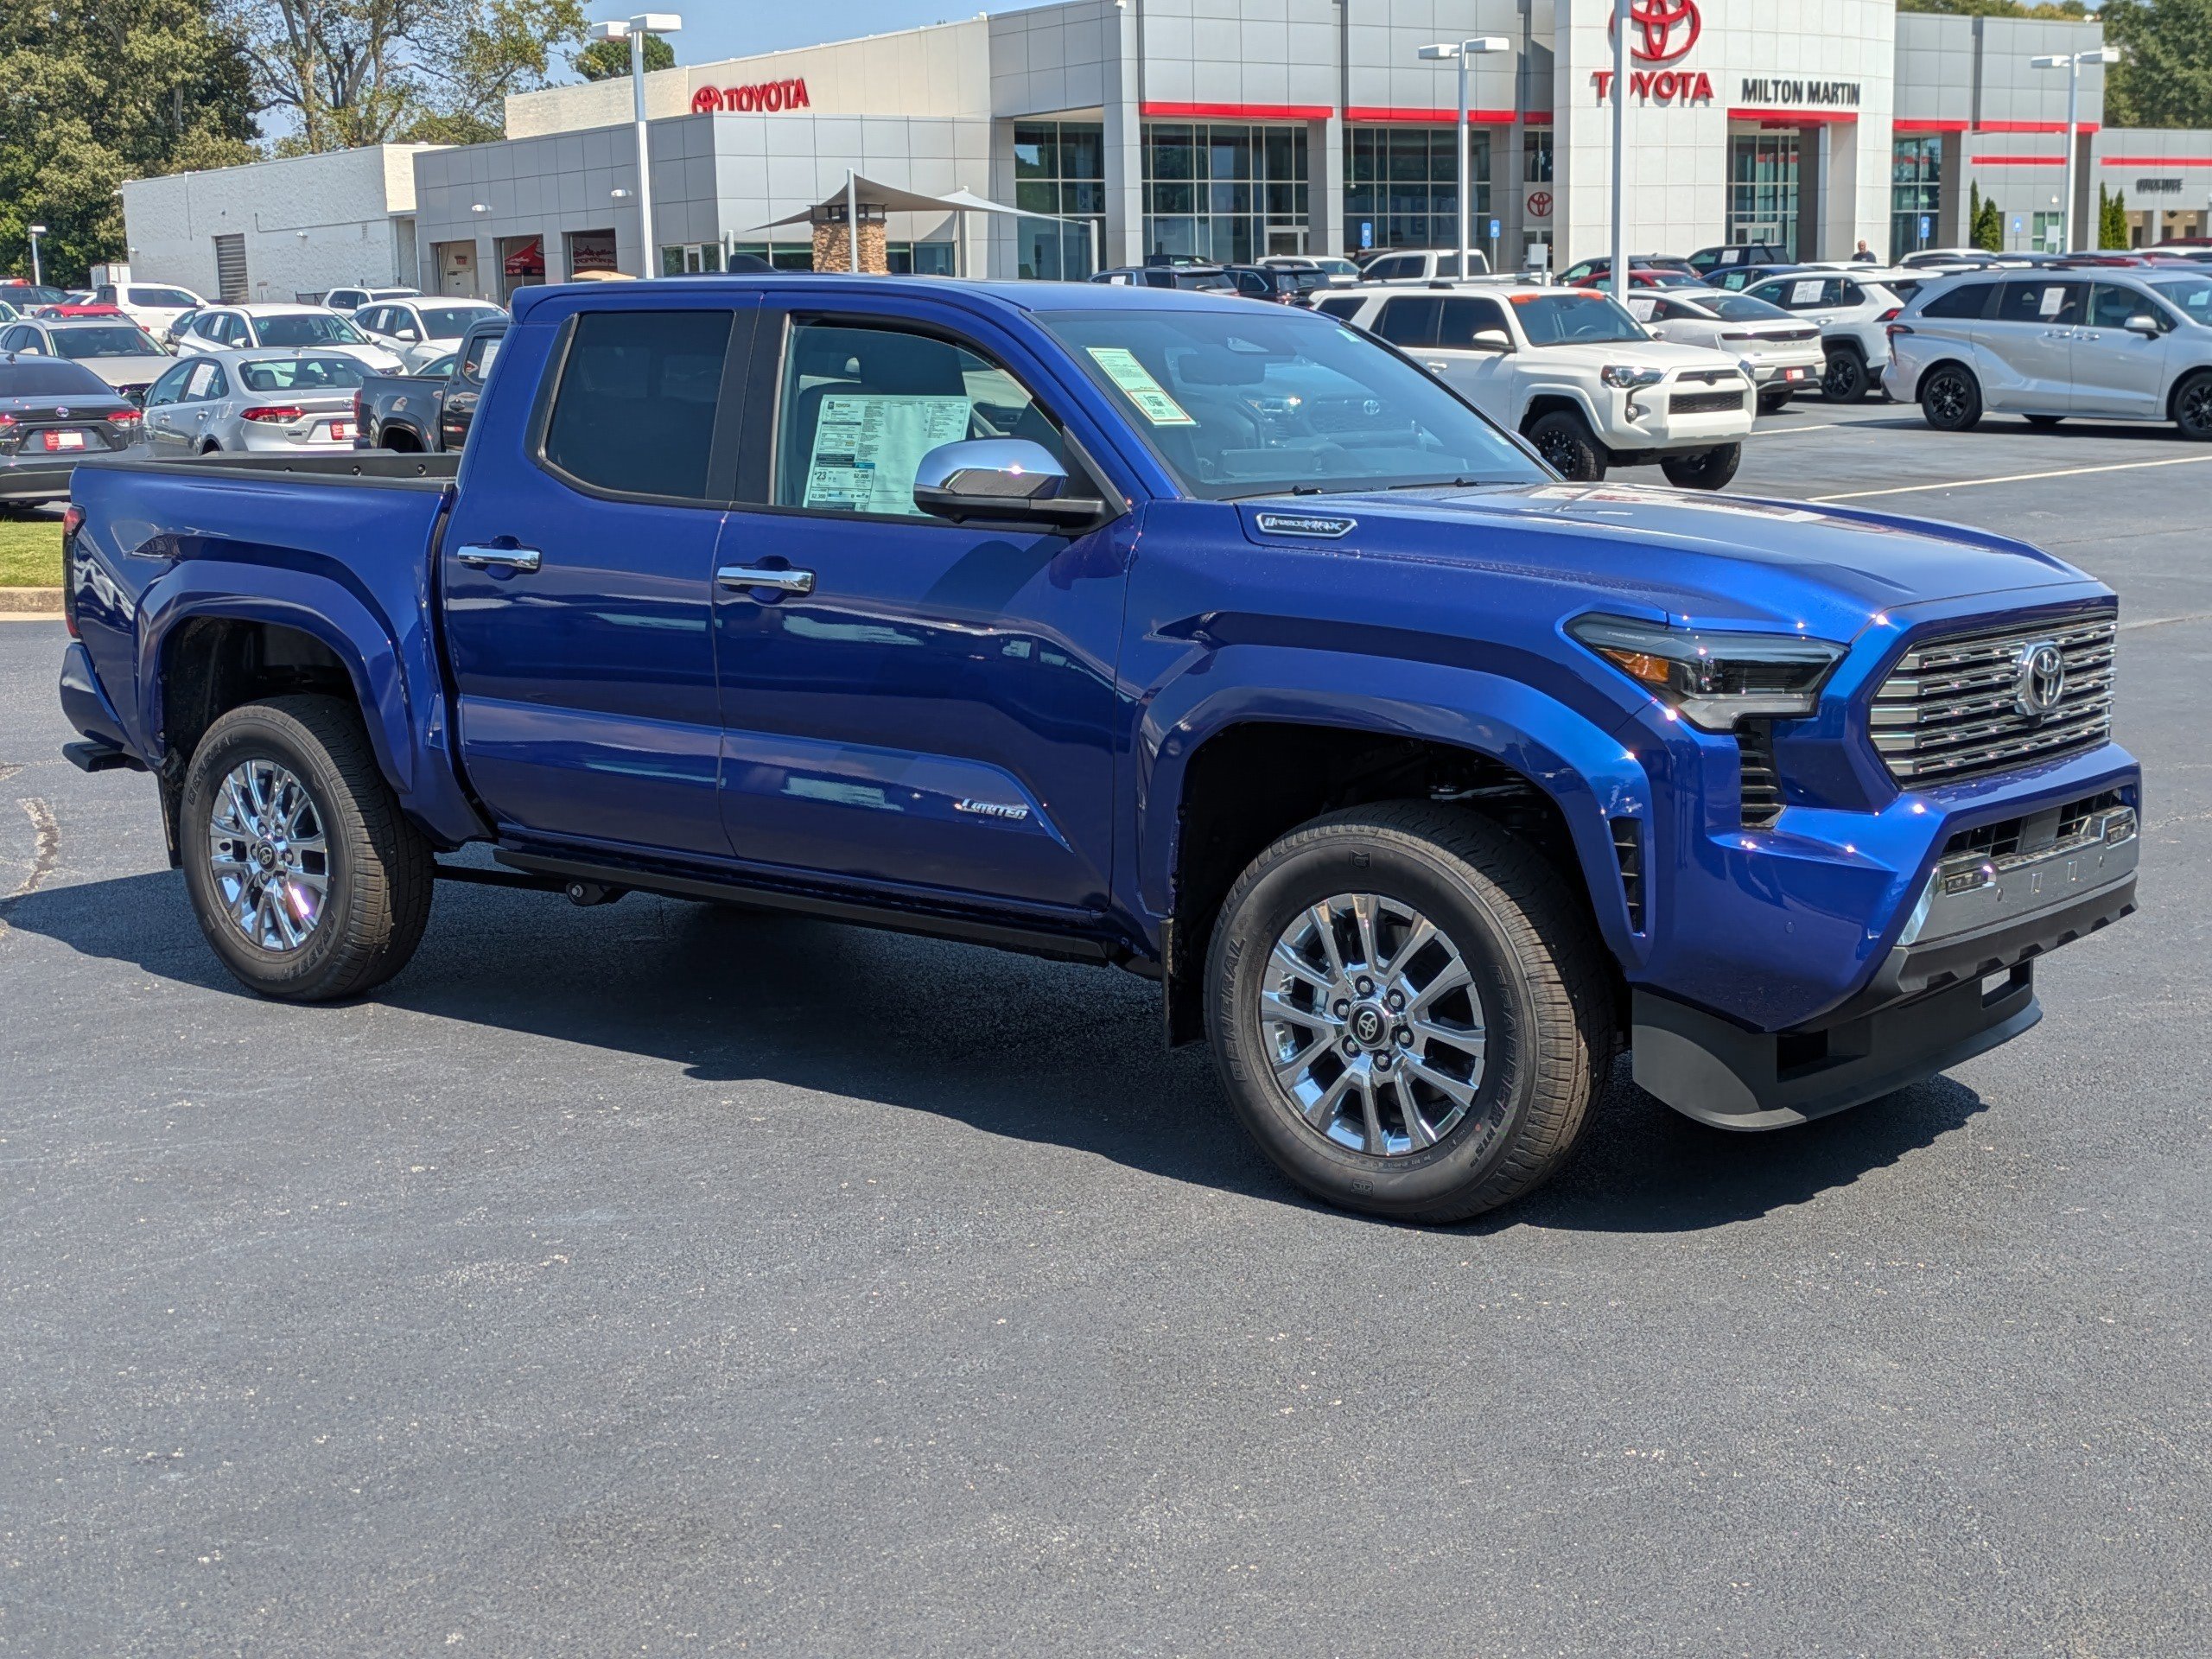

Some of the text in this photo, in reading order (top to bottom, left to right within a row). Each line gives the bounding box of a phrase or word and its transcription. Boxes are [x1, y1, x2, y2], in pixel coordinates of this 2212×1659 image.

[723, 78, 810, 112] TOYOTA
[1592, 71, 1714, 99] TYOTA
[1742, 78, 1860, 106] MILTON MARTIN
[1220, 936, 1249, 1081] GENERAL
